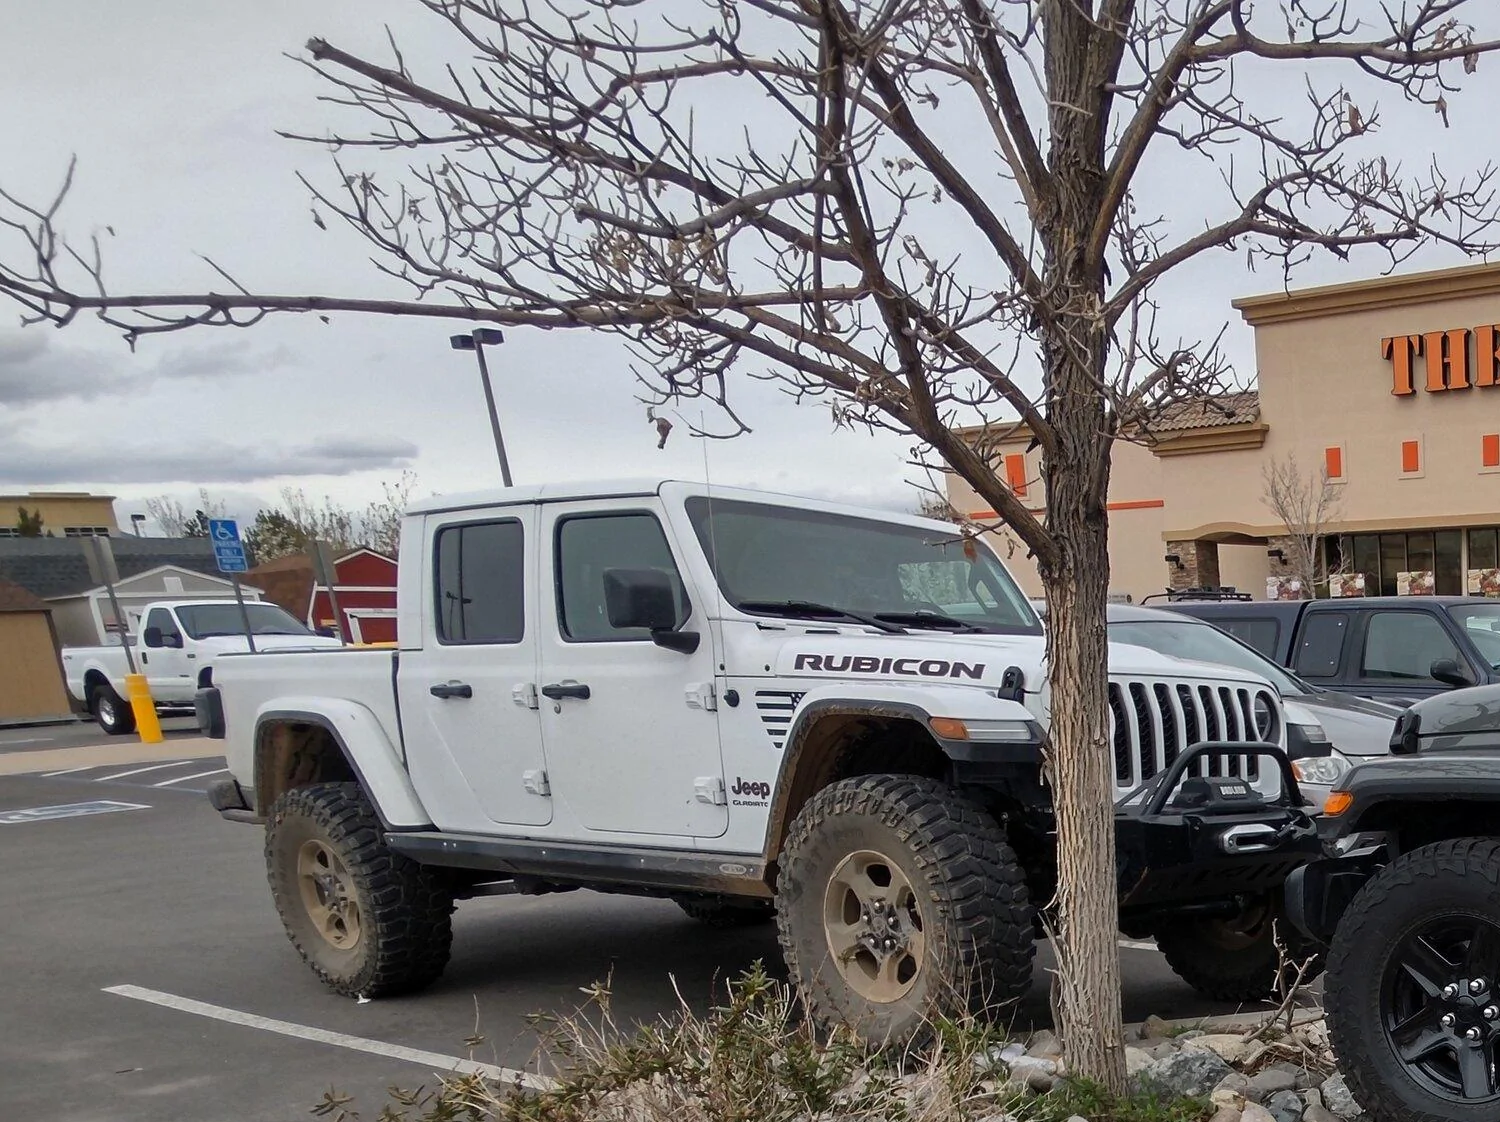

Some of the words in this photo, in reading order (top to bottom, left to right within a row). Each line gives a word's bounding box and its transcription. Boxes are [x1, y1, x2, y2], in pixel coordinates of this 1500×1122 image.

[794, 654, 986, 680] RUBICON
[731, 776, 770, 799] Jeep
[732, 800, 769, 808] GLADIATO
